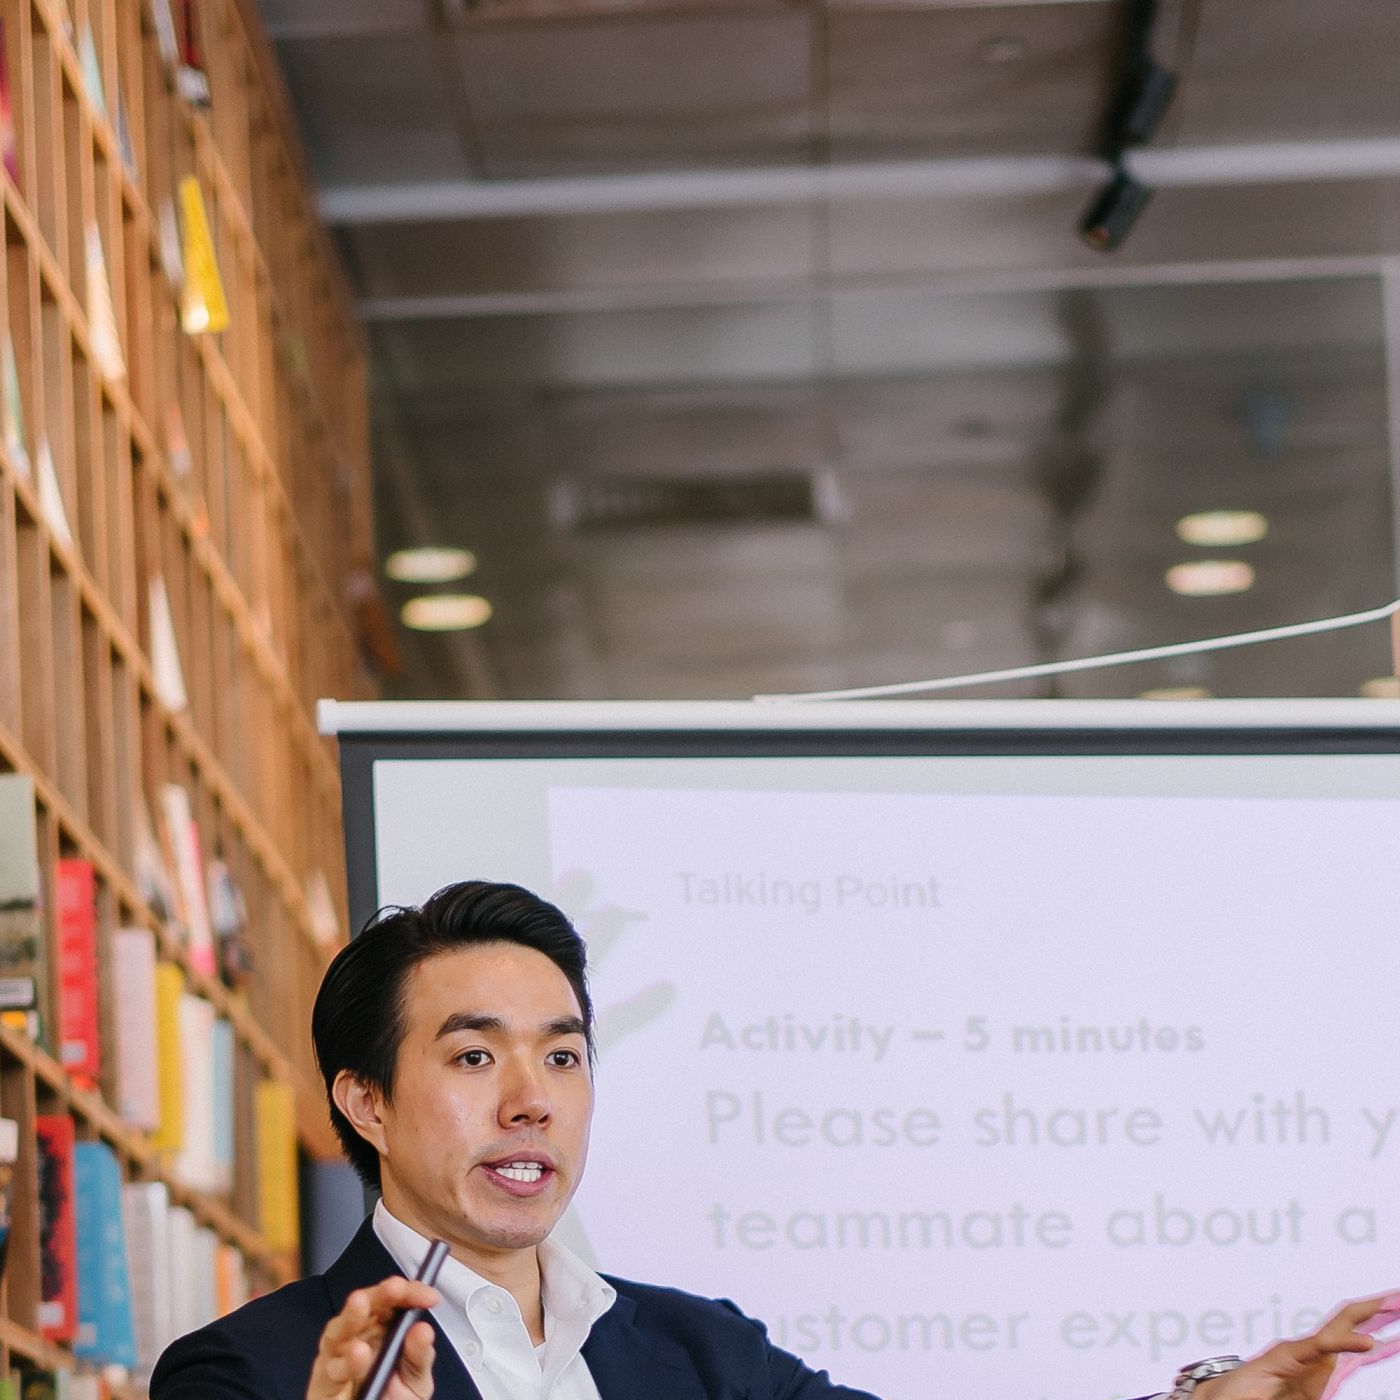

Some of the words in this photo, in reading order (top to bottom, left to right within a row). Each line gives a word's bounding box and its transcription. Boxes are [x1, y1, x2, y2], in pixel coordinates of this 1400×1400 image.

[675, 871, 821, 915] Talking
[836, 874, 942, 908] Point
[699, 1012, 894, 1063] Activity
[963, 1015, 992, 1053] 5
[1013, 1014, 1206, 1053] minutes
[705, 1089, 943, 1147] Please
[974, 1089, 1164, 1147] share
[1193, 1089, 1331, 1145] with
[707, 1202, 1074, 1250] teammate
[1106, 1192, 1307, 1247] about
[1335, 1206, 1377, 1245] a
